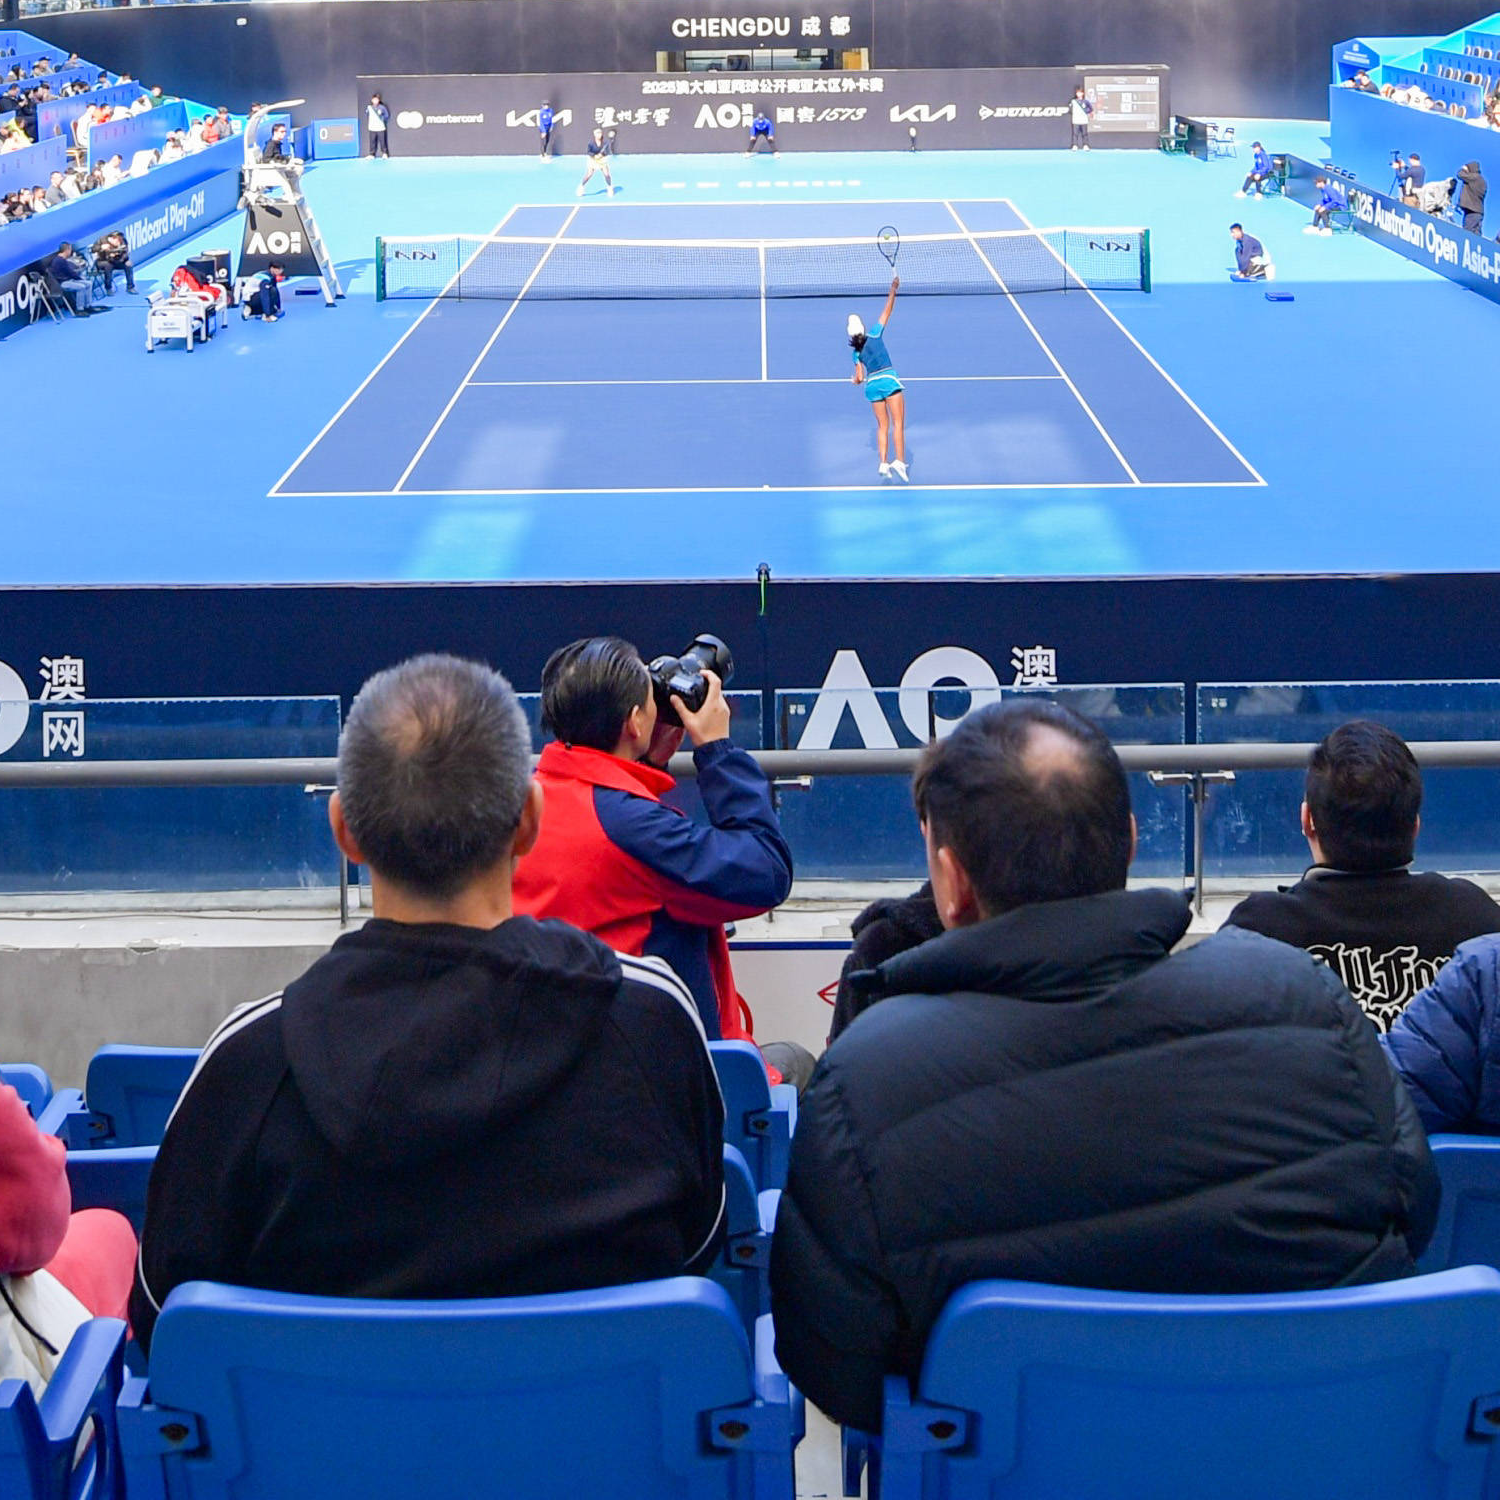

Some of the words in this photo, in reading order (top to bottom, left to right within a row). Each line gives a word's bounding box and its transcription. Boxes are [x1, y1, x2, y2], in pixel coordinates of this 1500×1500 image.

[671, 17, 790, 37] CHENGDU
[426, 112, 484, 124] mastercard
[694, 103, 741, 128] AO
[993, 106, 1070, 118] DUNLOP
[126, 204, 169, 252] Wildcard
[169, 190, 205, 232] Play-Off
[1374, 199, 1424, 249] Australian
[1426, 222, 1458, 265] Open
[247, 231, 290, 255] AO
[39, 655, 86, 758] 澳网
[796, 646, 1001, 750] AO
